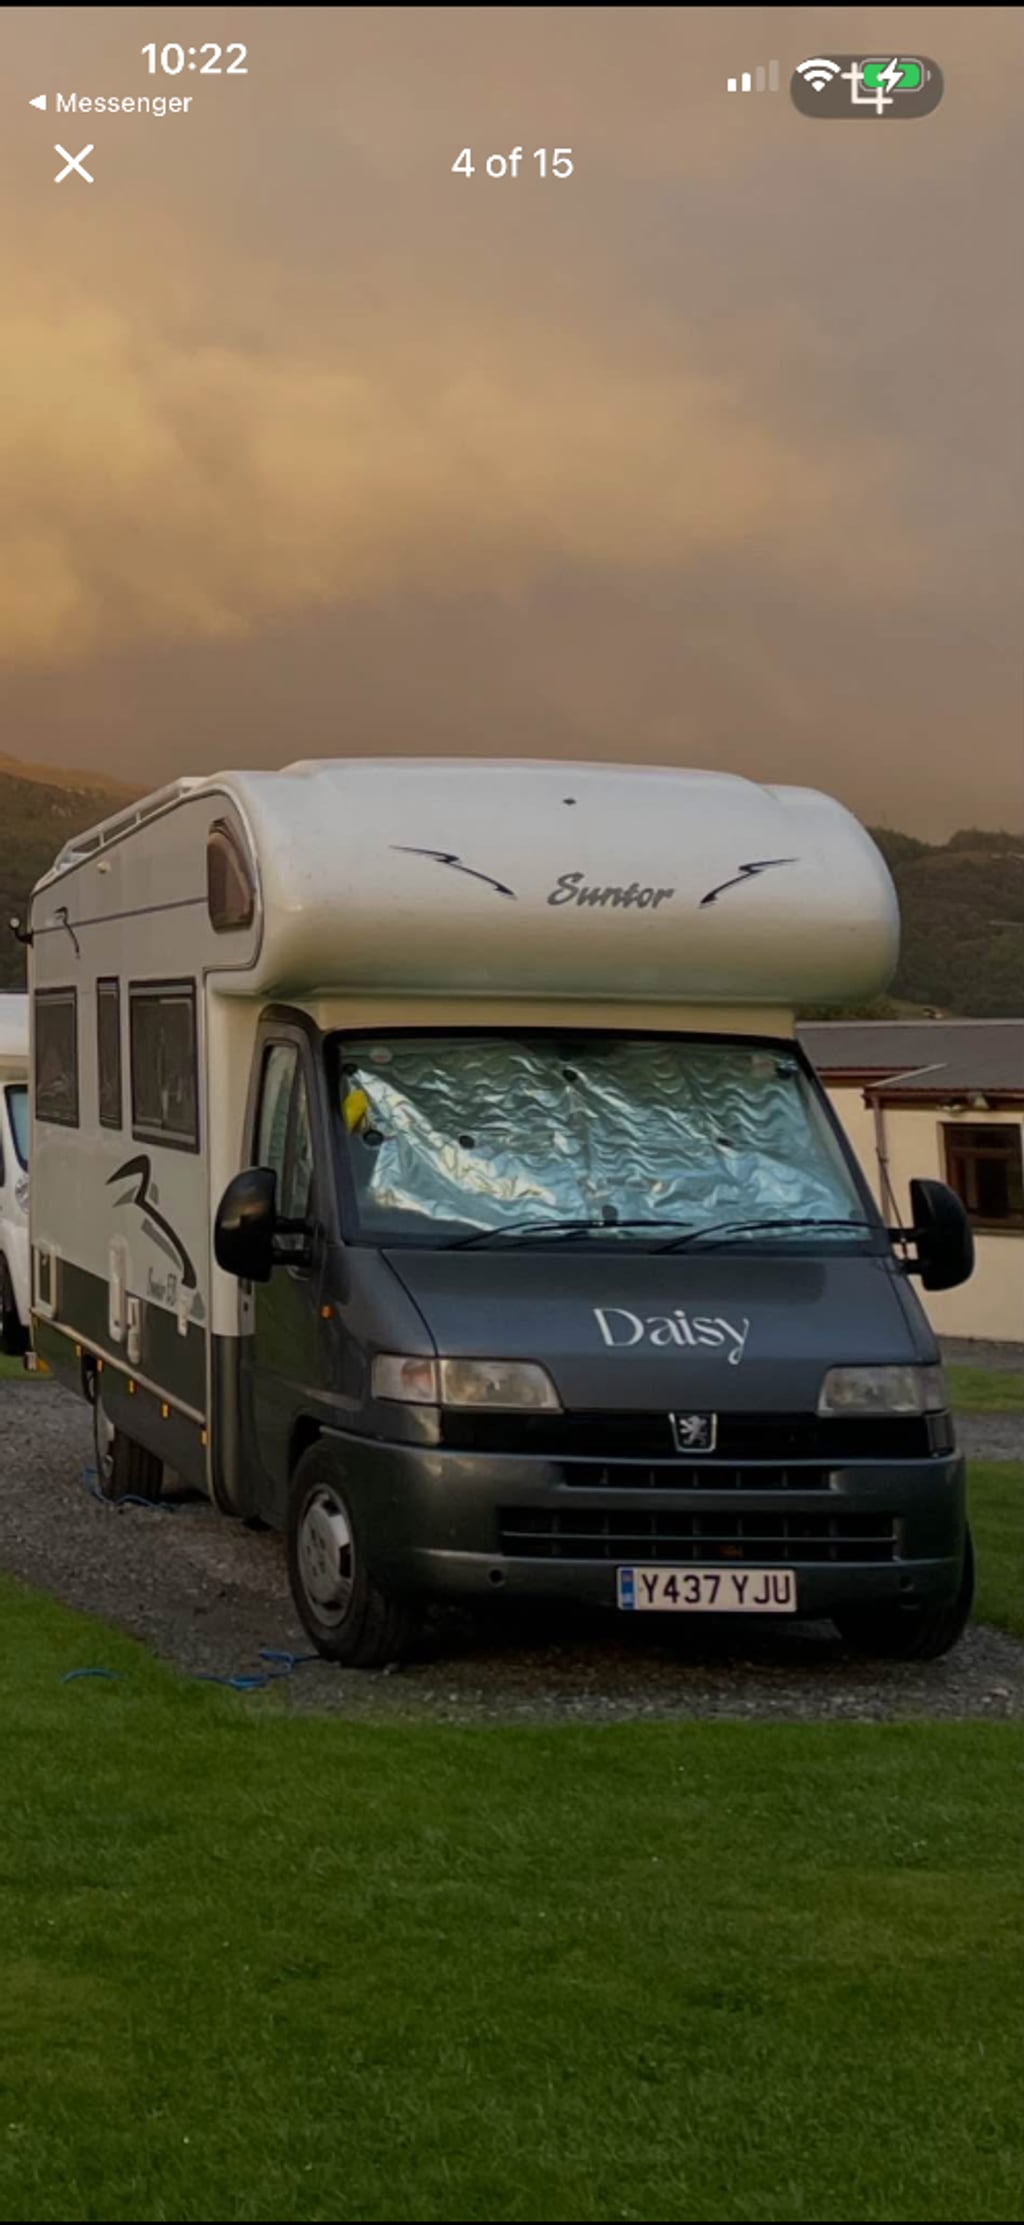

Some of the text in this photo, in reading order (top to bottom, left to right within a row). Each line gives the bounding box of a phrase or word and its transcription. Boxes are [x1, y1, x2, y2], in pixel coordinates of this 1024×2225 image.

[547, 872, 675, 908] Suntor
[593, 1308, 750, 1365] Daisy
[641, 1573, 791, 1605] Y437 YJU
